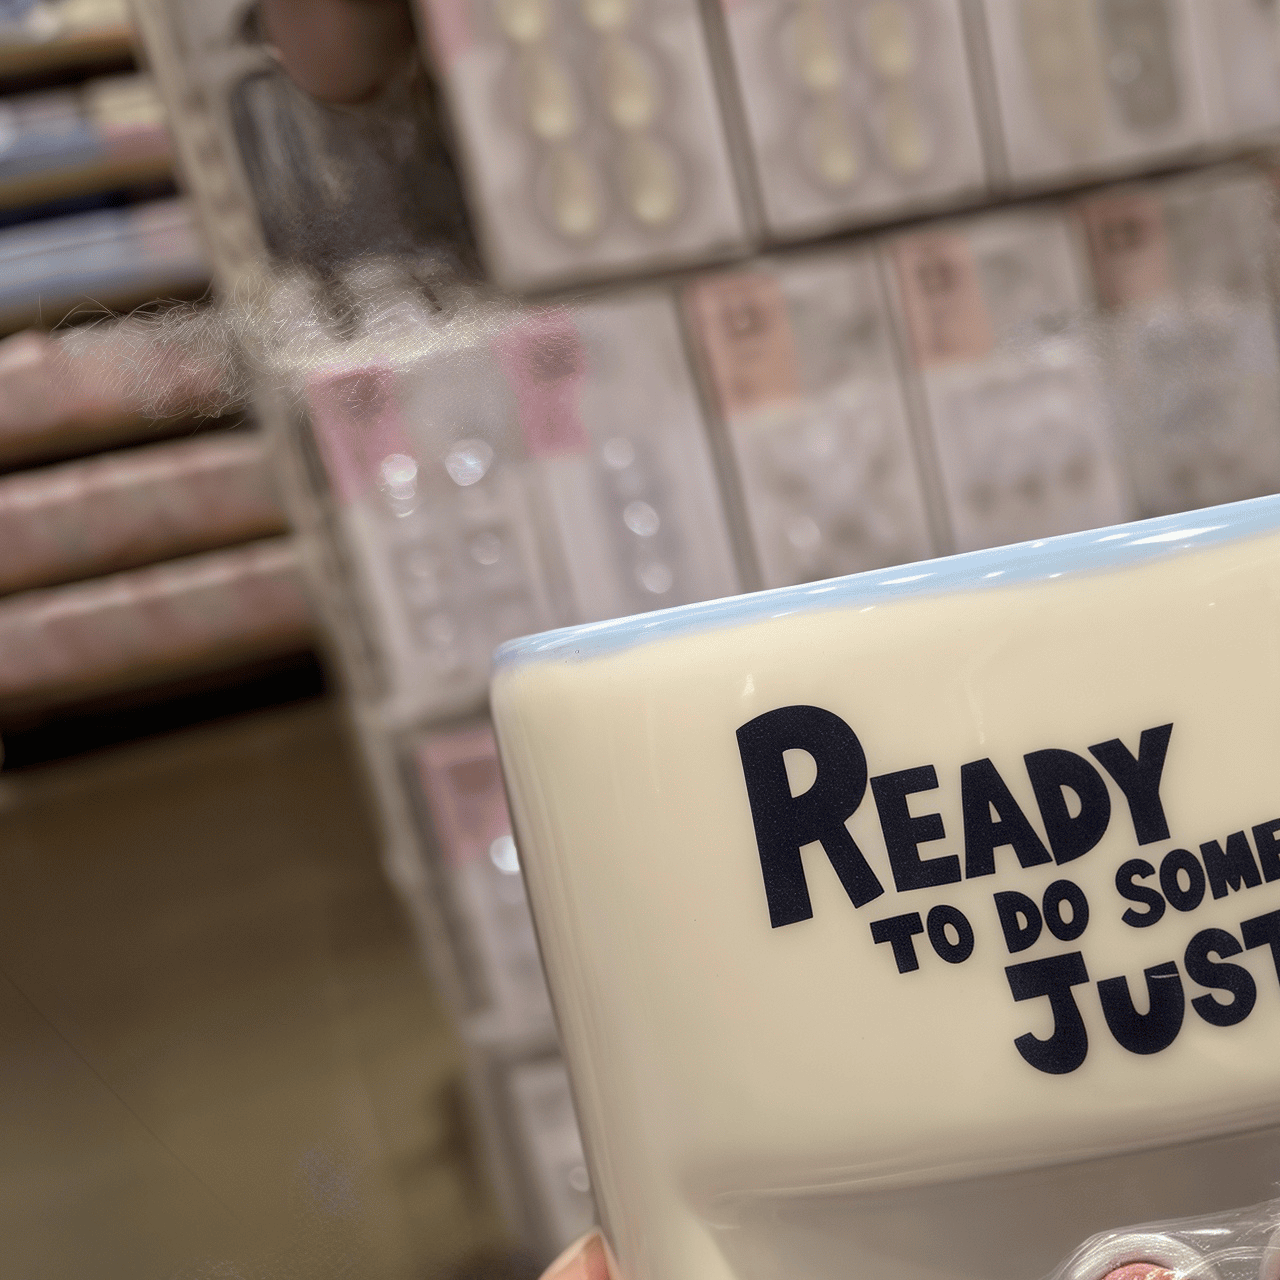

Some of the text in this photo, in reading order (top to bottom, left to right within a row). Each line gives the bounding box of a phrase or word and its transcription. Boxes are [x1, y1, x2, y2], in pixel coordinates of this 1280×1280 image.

[736, 705, 1173, 928] READY
[870, 905, 974, 974] TO
[993, 880, 1089, 953] DO
